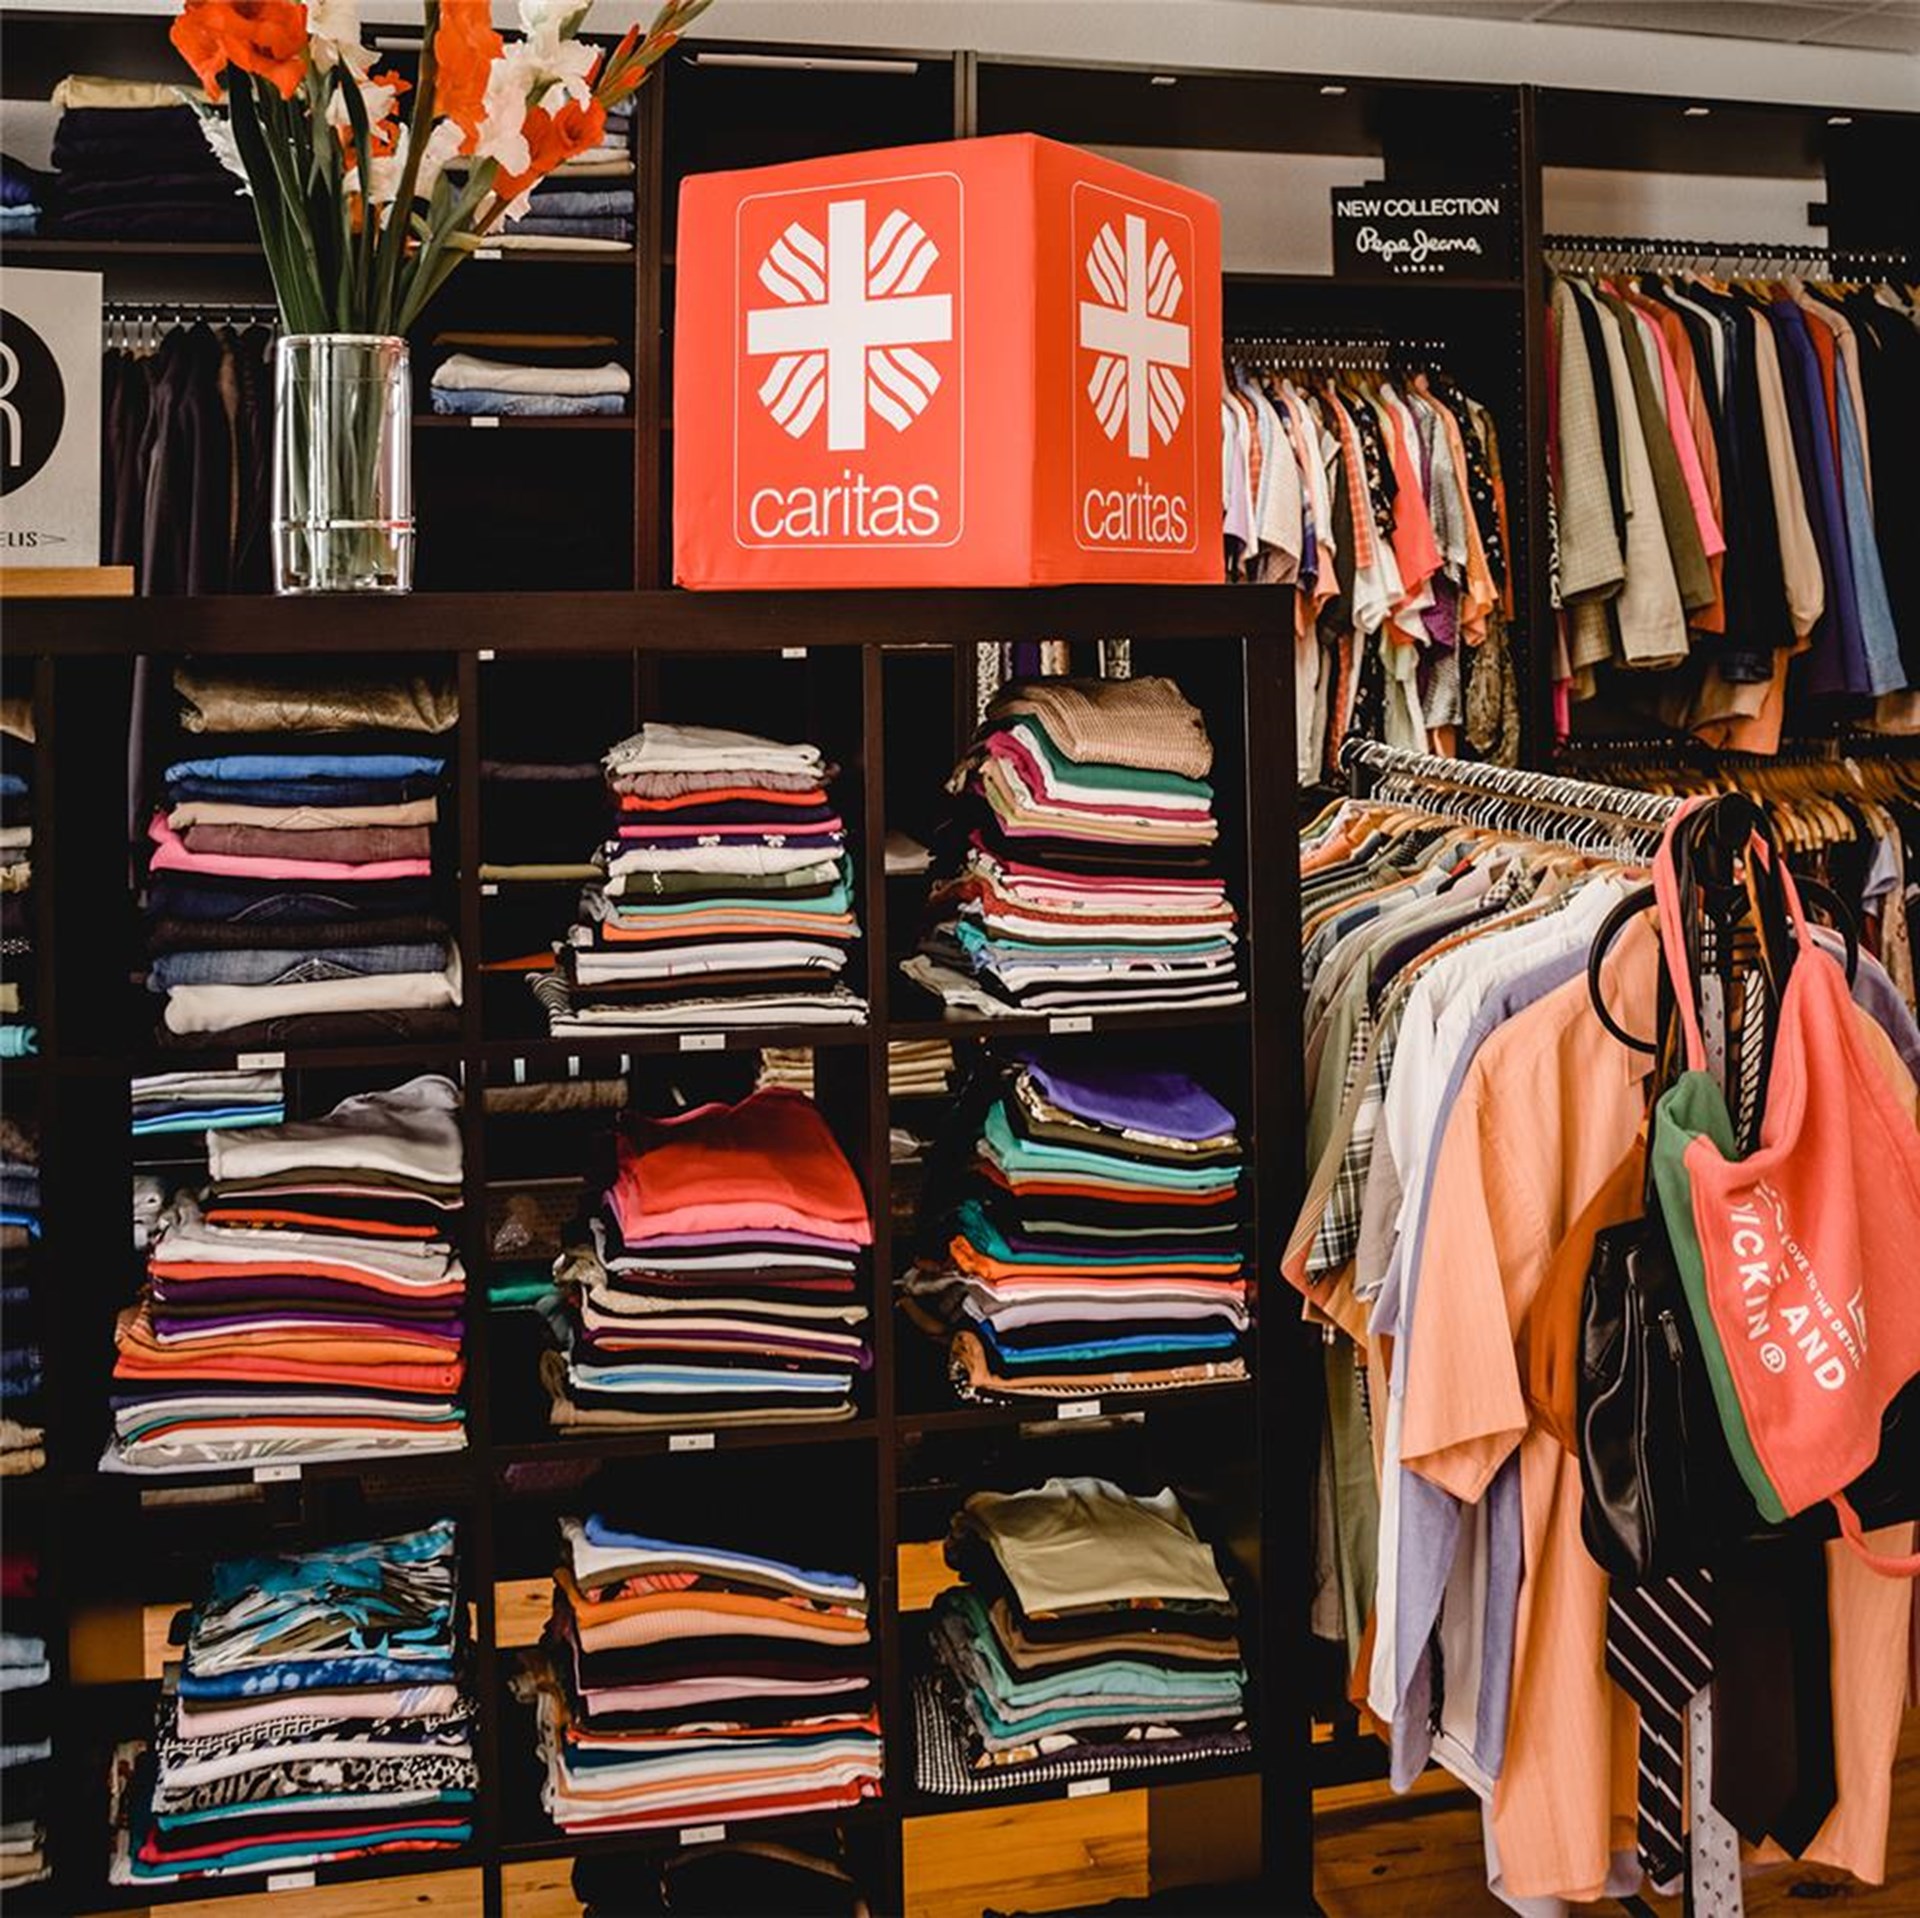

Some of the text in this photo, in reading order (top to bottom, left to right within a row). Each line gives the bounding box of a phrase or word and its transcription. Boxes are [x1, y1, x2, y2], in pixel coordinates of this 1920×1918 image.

[1337, 198, 1499, 217] NEW COLLECTION
[1356, 226, 1411, 262] Pepe
[750, 469, 940, 539] caritas
[1084, 476, 1187, 543] caritas
[1813, 1290, 1835, 1320] THE
